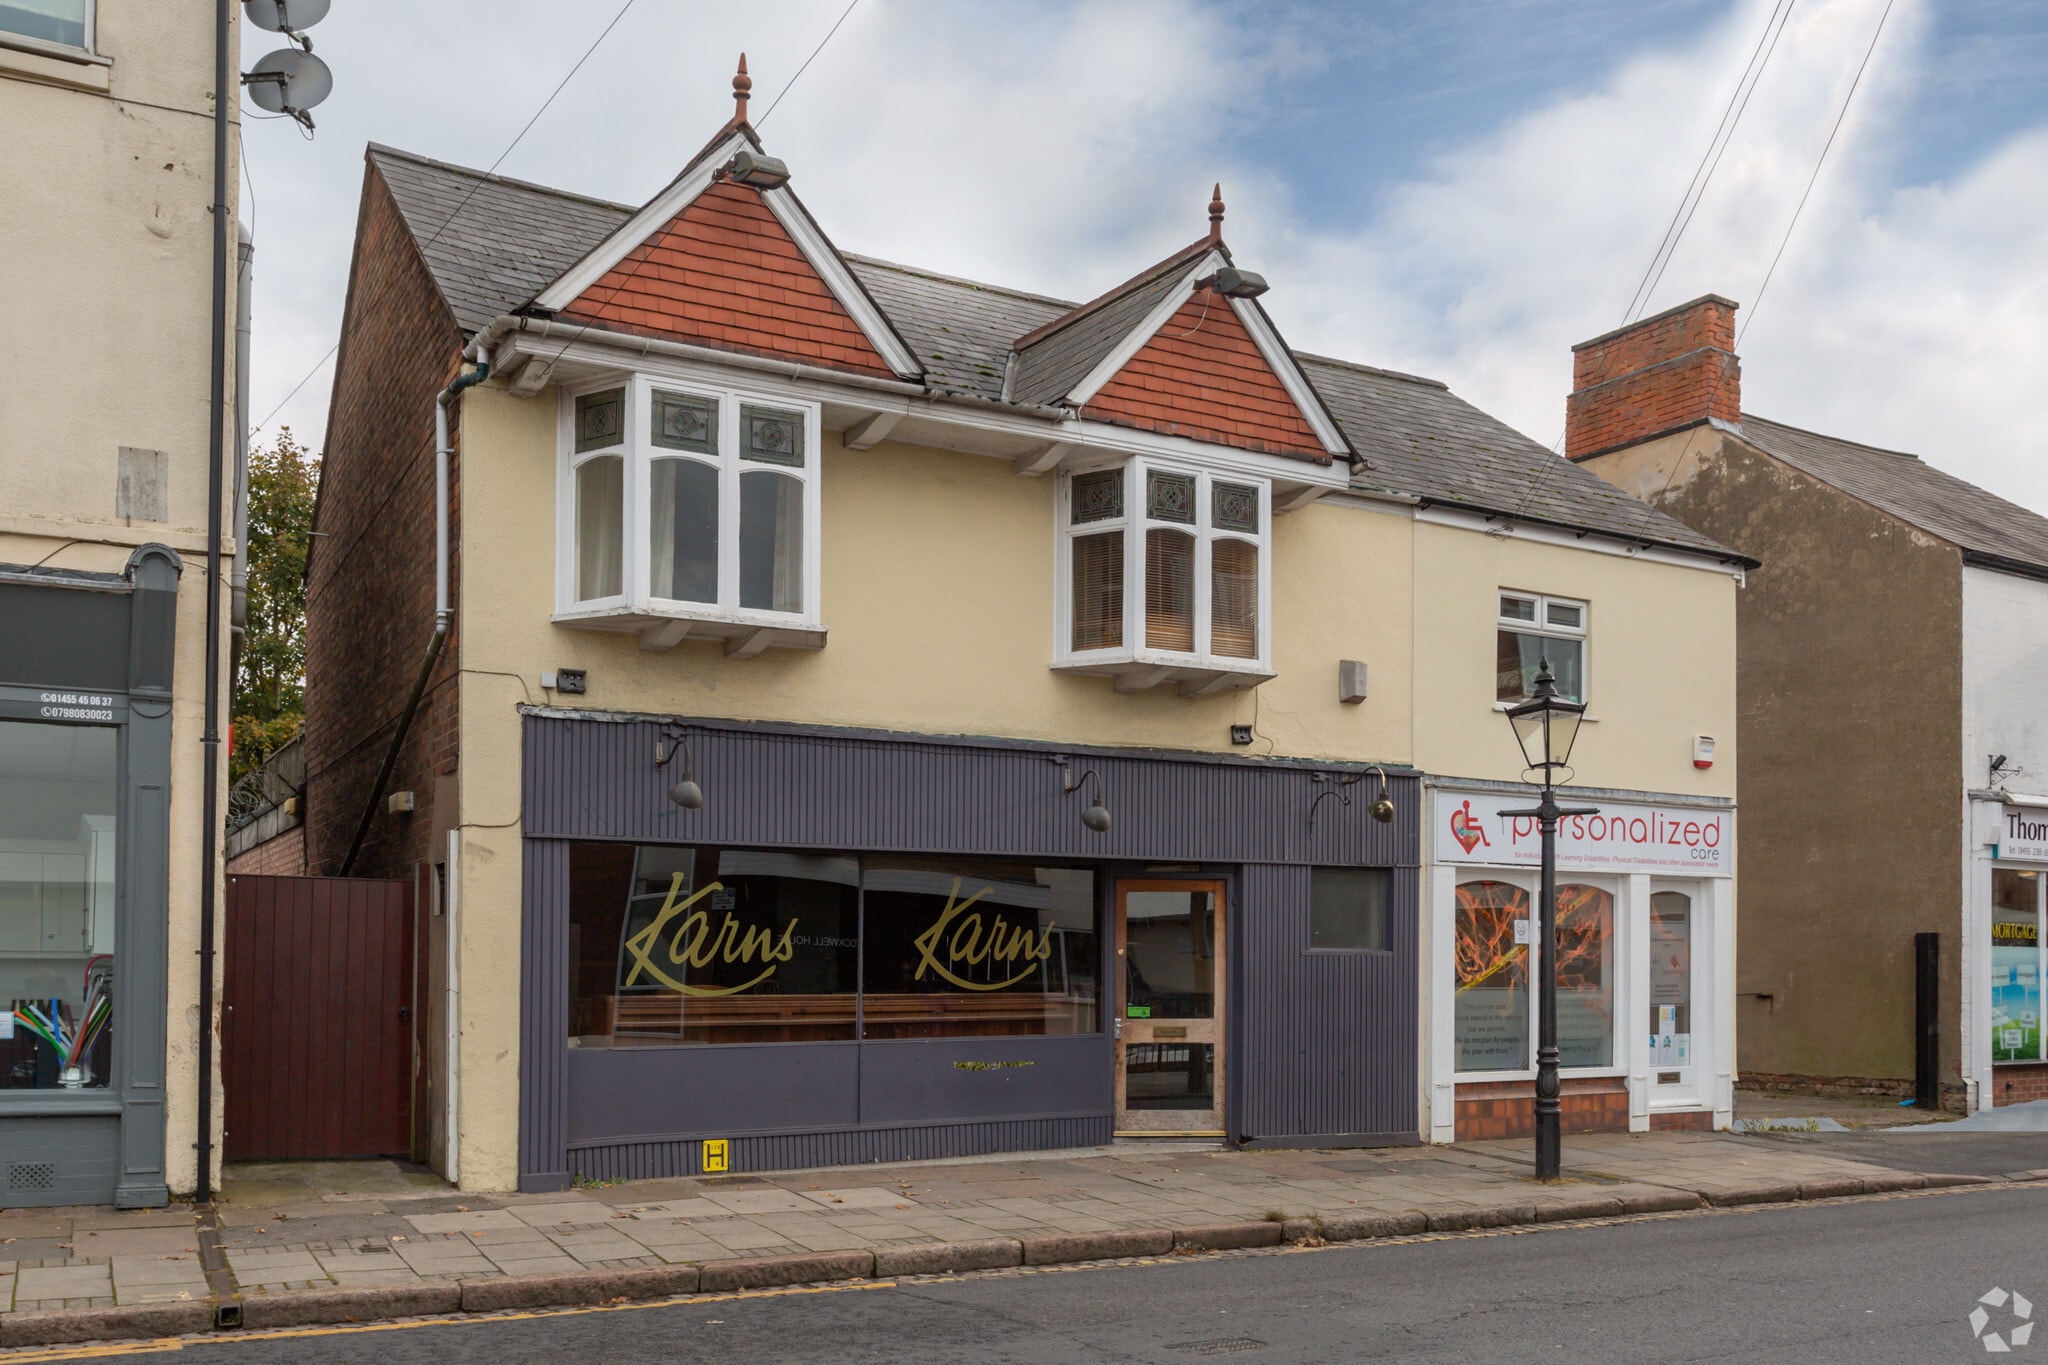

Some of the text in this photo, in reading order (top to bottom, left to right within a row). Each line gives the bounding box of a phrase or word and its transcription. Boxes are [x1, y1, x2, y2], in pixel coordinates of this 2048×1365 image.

[51, 693, 112, 706] 01455 45 06 37
[52, 707, 112, 720] 07980830023
[1512, 811, 1720, 848] prsonalized
[1562, 854, 1583, 862] Learning
[1612, 856, 1632, 864] Physical
[1690, 848, 1720, 861] care
[625, 871, 798, 997] Karns
[914, 877, 1055, 991] Karns
[707, 1143, 724, 1168] H
